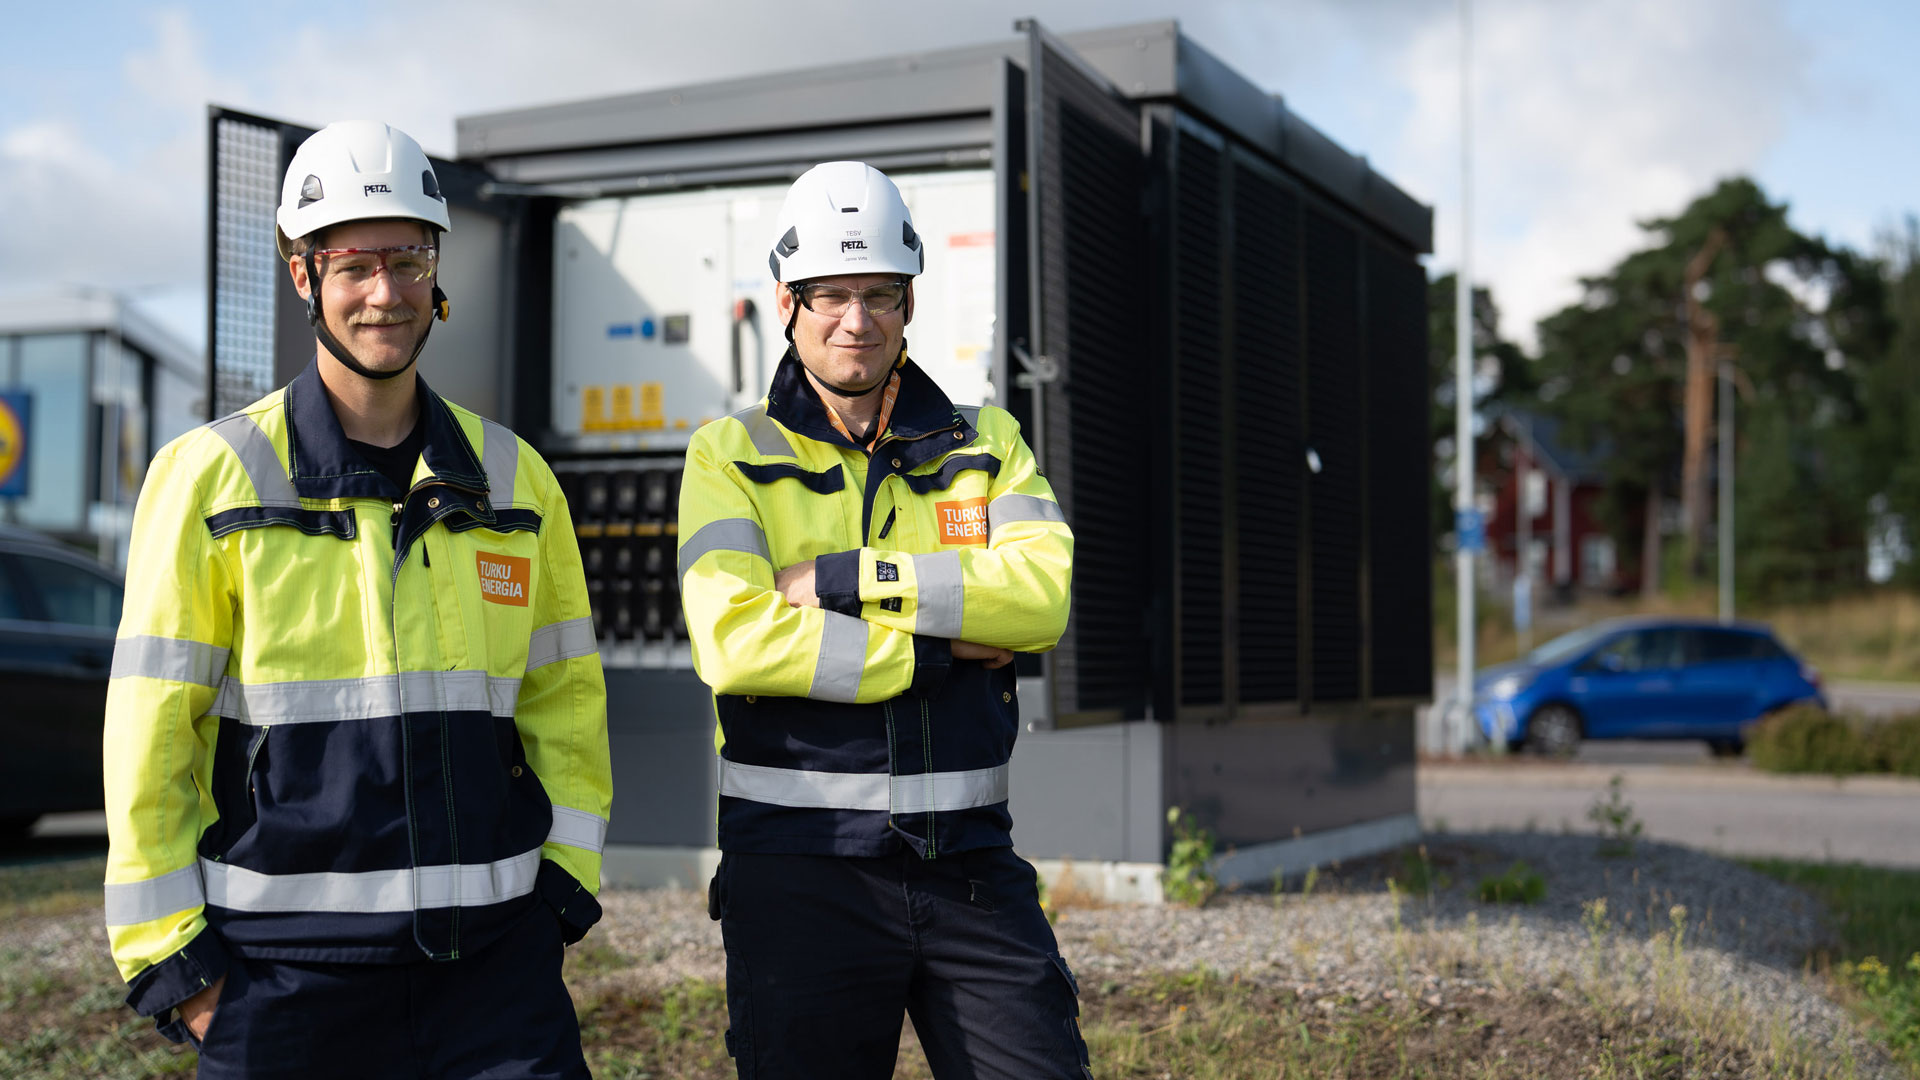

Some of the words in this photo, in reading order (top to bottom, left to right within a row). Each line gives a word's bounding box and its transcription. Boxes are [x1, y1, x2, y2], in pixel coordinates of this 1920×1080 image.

[363, 184, 392, 197] PETZL
[841, 240, 868, 253] PETZL
[943, 505, 987, 523] TURKU
[945, 521, 988, 537] ENERG
[480, 560, 512, 580] TURKU
[481, 577, 523, 598] ENERGIA
